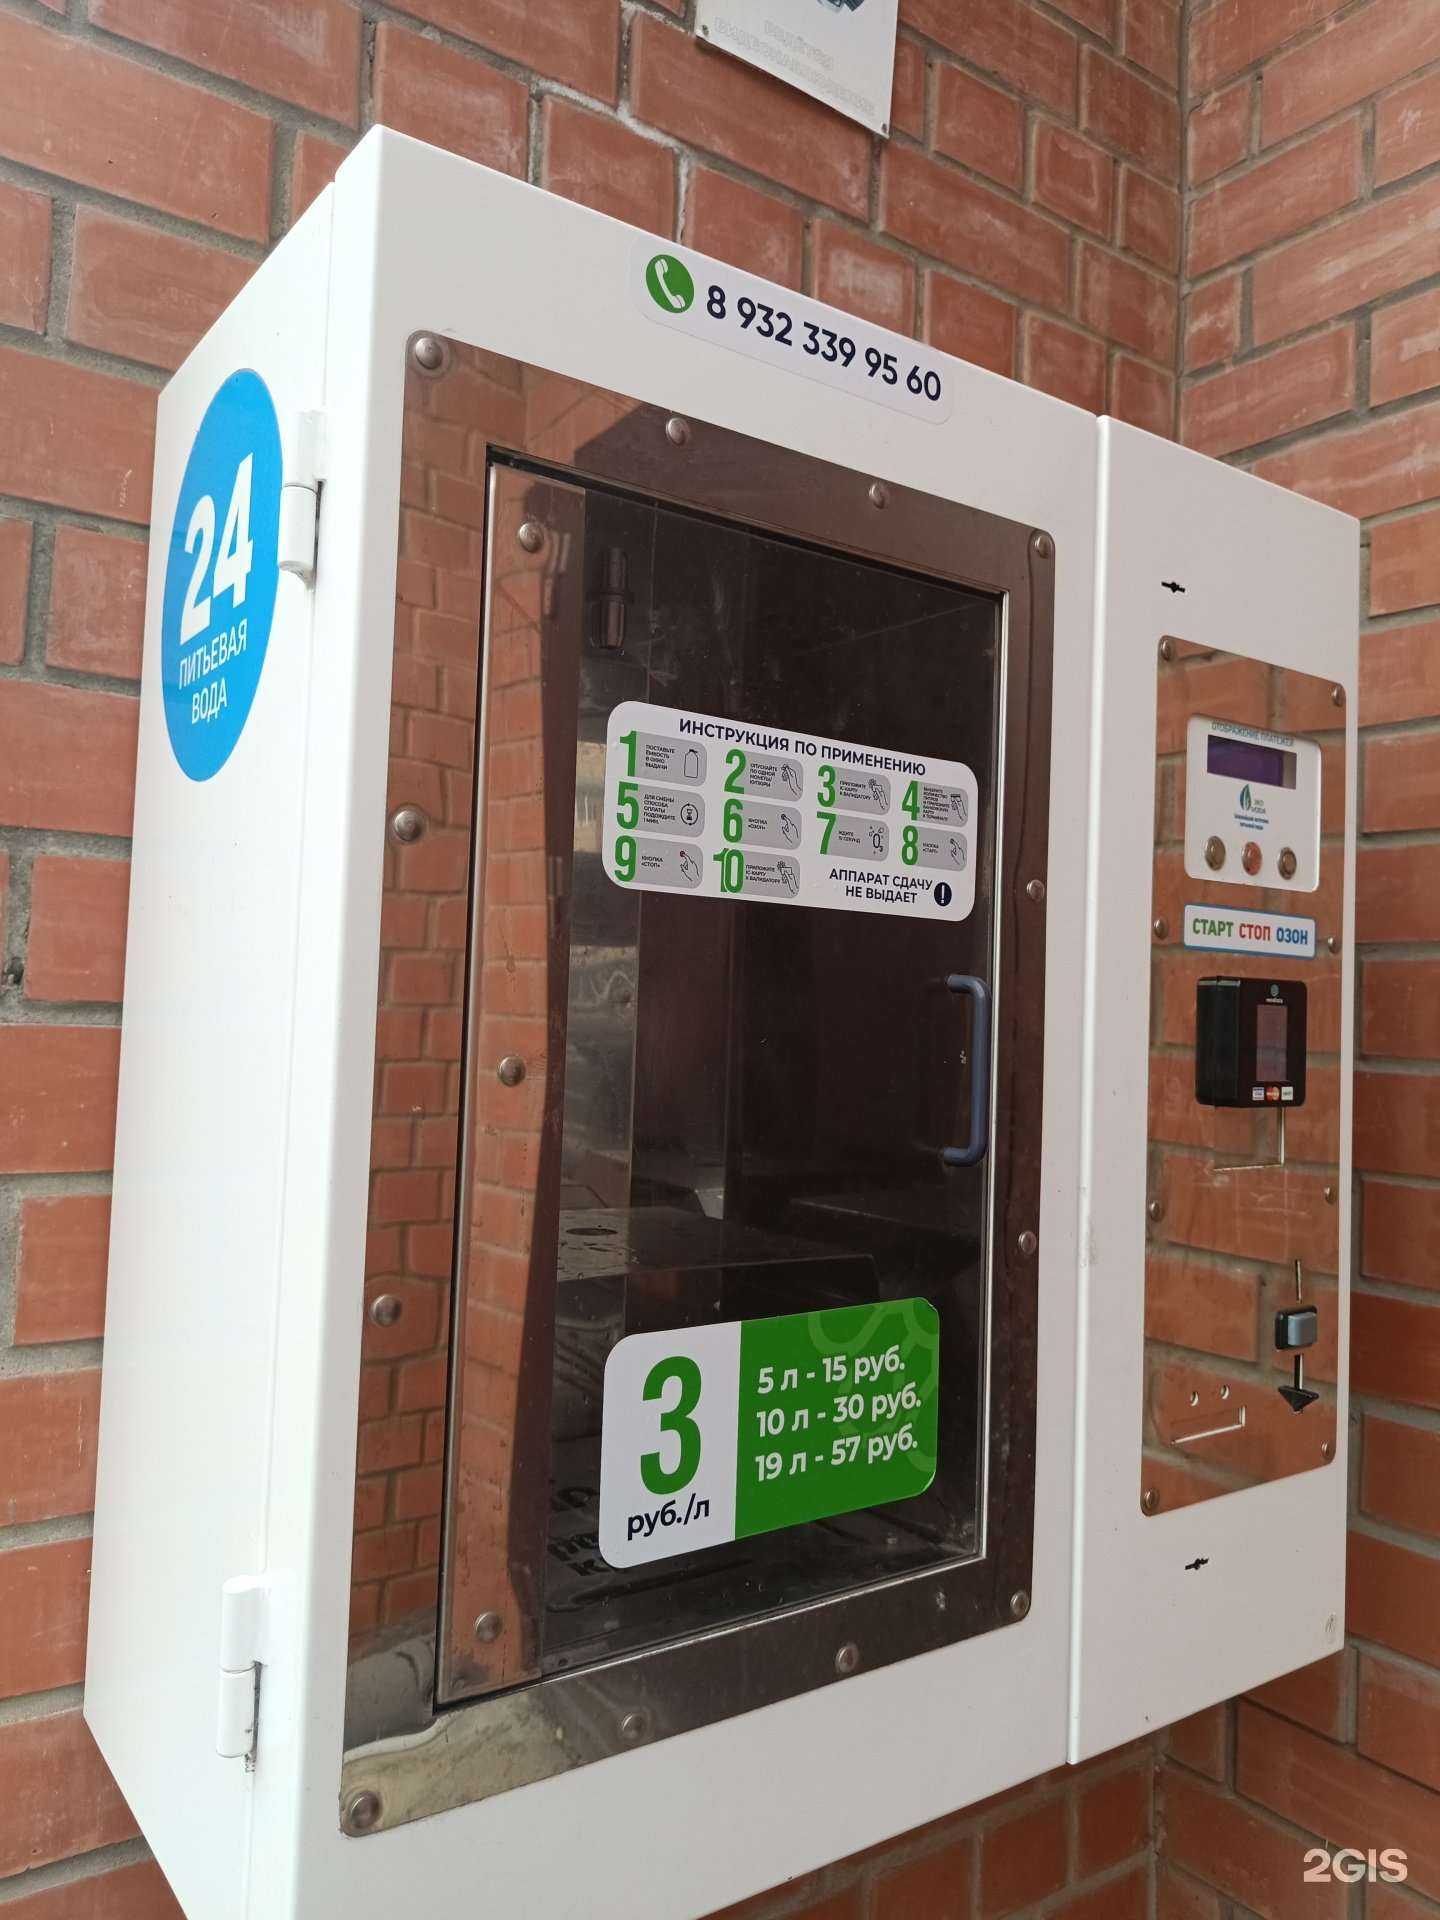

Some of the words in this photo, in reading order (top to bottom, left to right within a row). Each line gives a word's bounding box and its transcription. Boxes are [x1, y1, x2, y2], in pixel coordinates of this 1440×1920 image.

[706, 285, 726, 319] 8
[737, 296, 793, 346] 932
[802, 321, 856, 367] 339
[864, 347, 898, 385] 95
[906, 365, 942, 401] 60
[179, 451, 254, 646] 24
[179, 618, 248, 691] ПИТЬЕВАЯ
[191, 676, 228, 725] ВОДА
[619, 730, 637, 777] 1
[679, 718, 789, 752] ИНСТРУКЦИЯ
[795, 740, 817, 756] ПО
[821, 745, 926, 777] ПРИМЕНЕНИЮ
[724, 749, 746, 794] 2
[817, 764, 835, 807] 3
[617, 781, 639, 830] 5
[723, 798, 743, 843] 6
[902, 780, 920, 820] 4
[816, 811, 836, 854] 7
[902, 825, 918, 865] 8
[615, 835, 636, 882] 9
[713, 848, 744, 893] 10
[829, 868, 890, 888] АППАРАТ
[894, 877, 933, 892] СДАЧУ
[846, 886, 864, 899] НЕ
[865, 888, 918, 904] ВЫДАЕТ
[1192, 918, 1234, 938] СТАРТ
[1238, 923, 1271, 941] СТОП
[1276, 927, 1308, 945] ОЗОН
[757, 1366, 774, 1394] 5
[780, 1369, 798, 1391] л
[806, 1371, 815, 1379] -
[822, 1355, 846, 1383] 15
[854, 1344, 905, 1384] руб.
[640, 1356, 702, 1494] 3
[756, 1408, 784, 1437] 10
[791, 1409, 809, 1432] л
[833, 1396, 864, 1423] 30
[871, 1382, 922, 1422] руб.
[755, 1452, 782, 1482] 19
[789, 1453, 806, 1475] л
[815, 1455, 824, 1463] -
[831, 1435, 861, 1465] 57
[867, 1423, 918, 1463] руб.
[627, 1493, 710, 1540] руб./л
